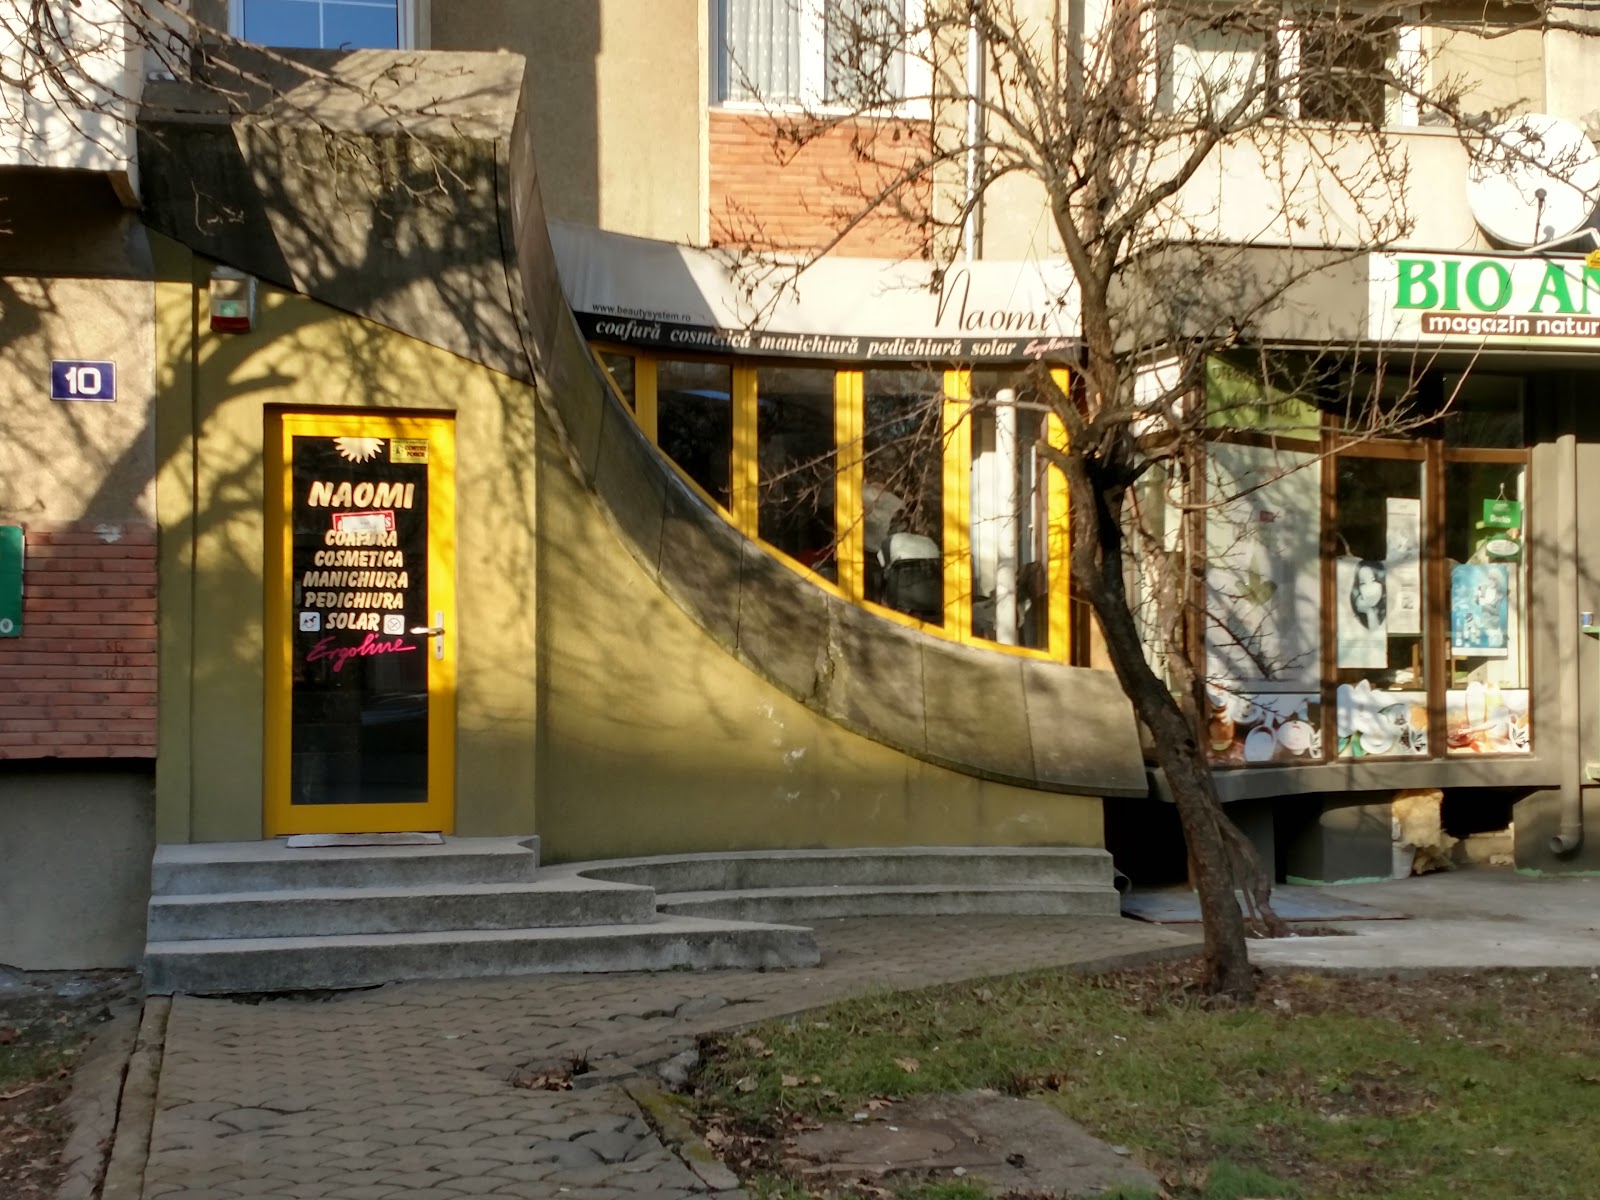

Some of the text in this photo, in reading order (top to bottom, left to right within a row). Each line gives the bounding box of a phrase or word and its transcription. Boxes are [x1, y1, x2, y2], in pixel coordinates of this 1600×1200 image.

[1393, 259, 1513, 312] BIO
[934, 268, 1051, 331] Naomi
[592, 303, 691, 322] www.beautysystem.ro
[1429, 315, 1600, 336] magazin natur
[595, 320, 661, 341] coafură
[760, 334, 860, 354] manichiură
[866, 337, 962, 359] pedichiură
[971, 339, 1017, 356] solar
[65, 366, 102, 395] 10
[307, 480, 415, 509] NAOMI
[325, 529, 398, 547] COAFURA
[314, 550, 404, 568] COSMETICA
[302, 570, 409, 589] MANICHIURA
[304, 591, 404, 610] PEDICHIURA
[325, 612, 381, 632] SOLAR
[306, 633, 417, 672] Ergoline
